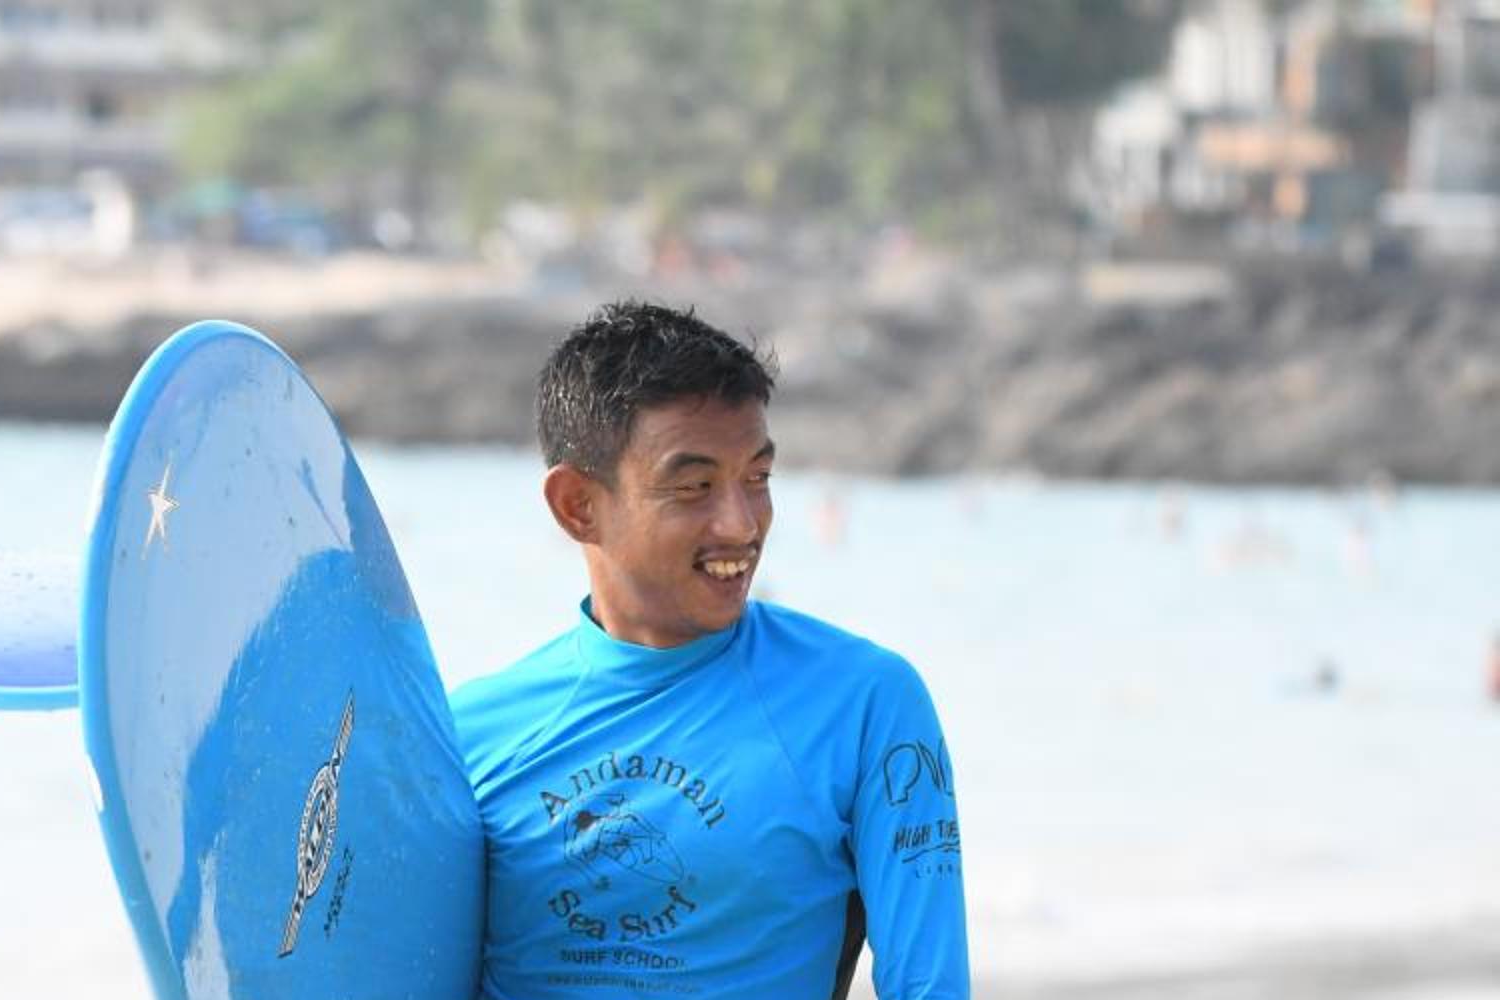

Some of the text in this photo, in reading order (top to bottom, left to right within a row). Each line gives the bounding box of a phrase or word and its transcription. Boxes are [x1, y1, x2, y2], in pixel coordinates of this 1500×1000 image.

[540, 752, 725, 829] Andaman
[548, 885, 696, 943] Sea Surf
